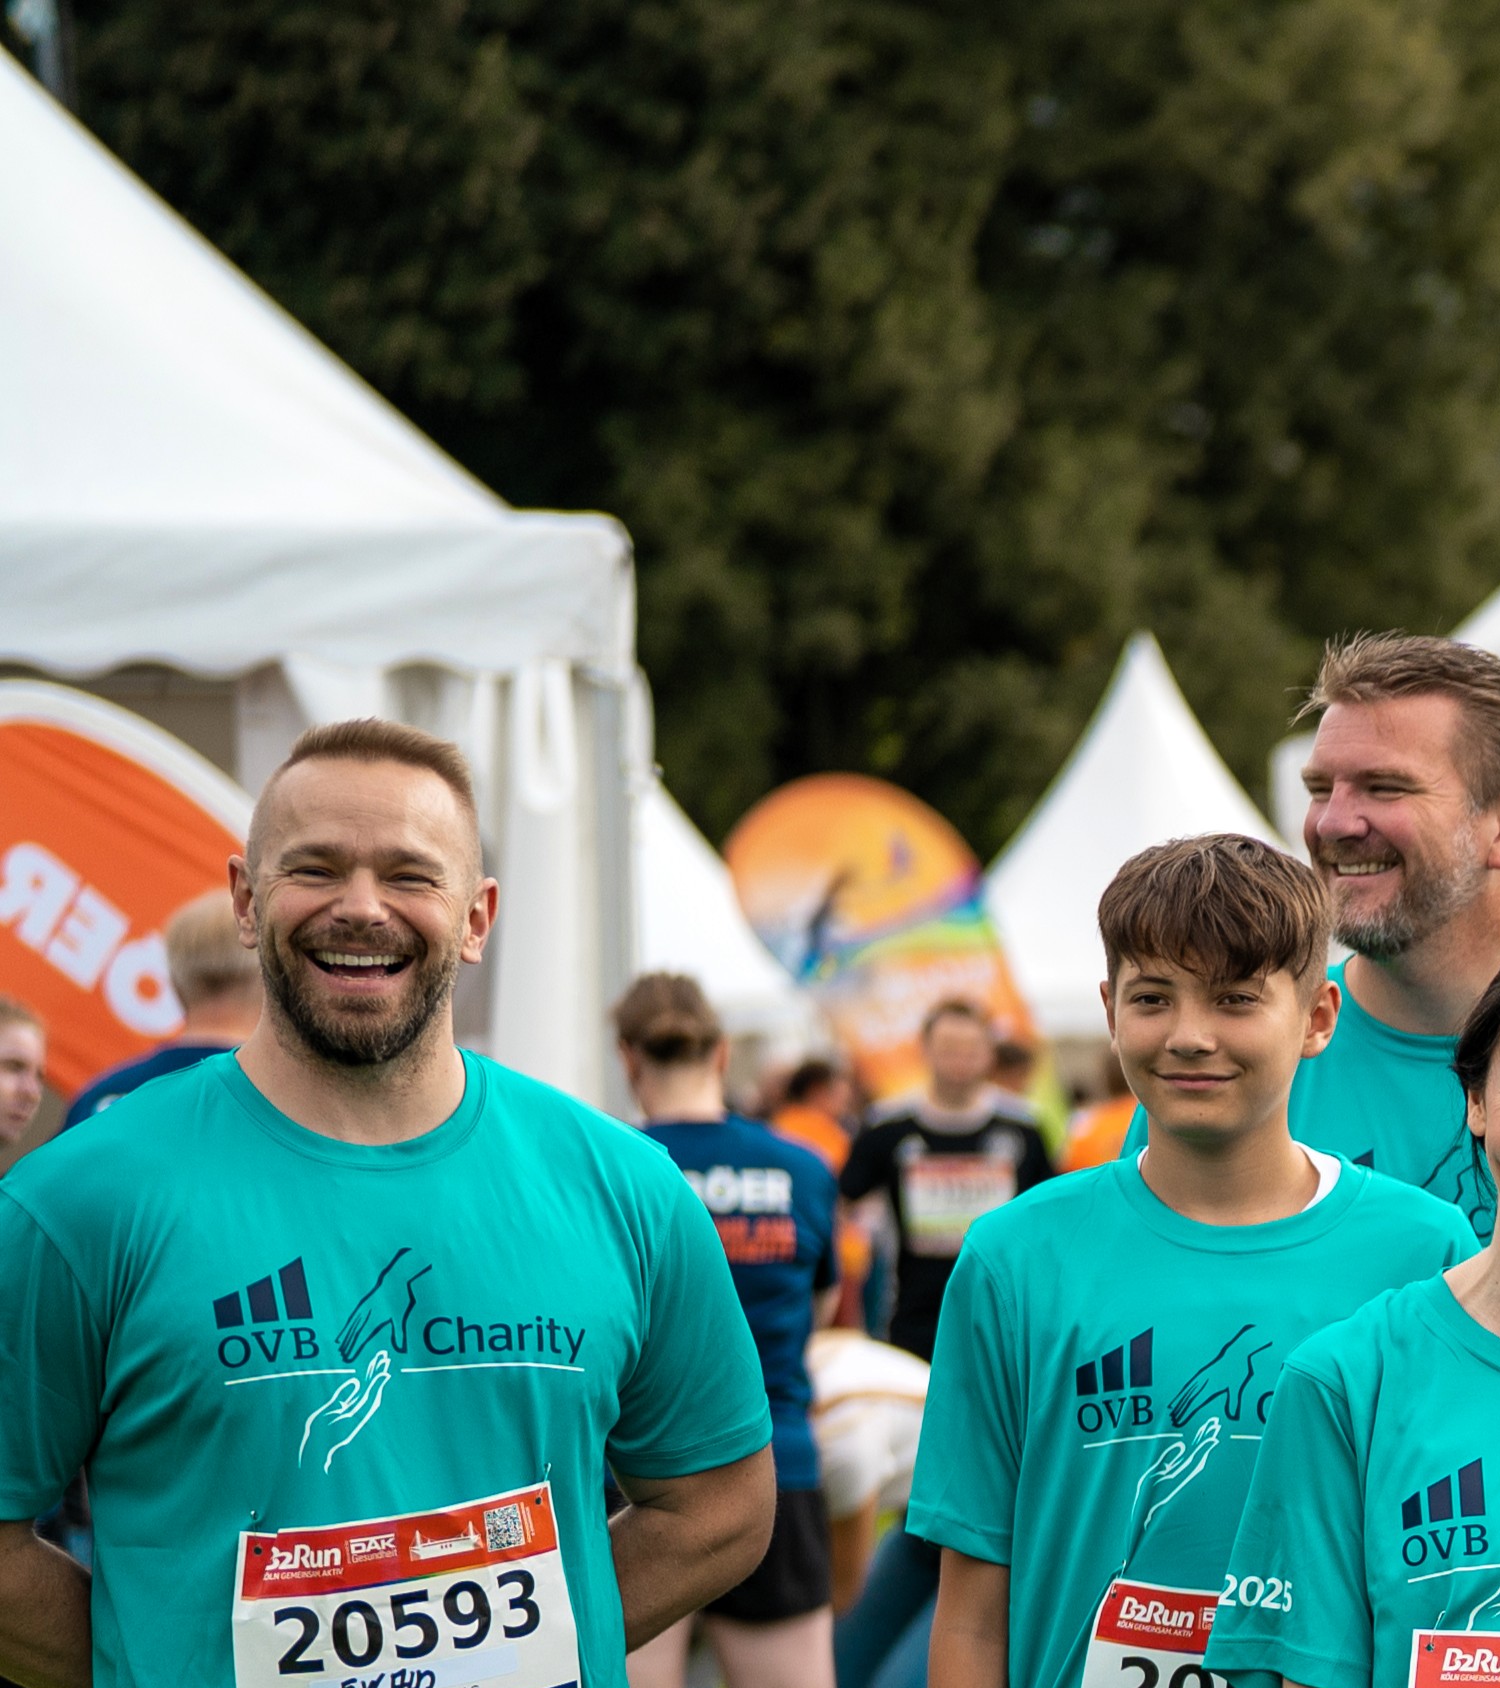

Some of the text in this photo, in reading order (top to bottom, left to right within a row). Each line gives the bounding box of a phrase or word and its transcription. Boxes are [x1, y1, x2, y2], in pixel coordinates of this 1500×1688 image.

[218, 1316, 585, 1368] OVB Charity
[1077, 1394, 1153, 1433] OVB
[350, 1533, 396, 1554] DAK
[352, 1549, 397, 1563] Gesundheit
[1402, 1523, 1488, 1567] OVB
[1119, 1596, 1194, 1628] B2Run
[1219, 1574, 1292, 1612] 2025
[273, 1569, 541, 1674] 20593
